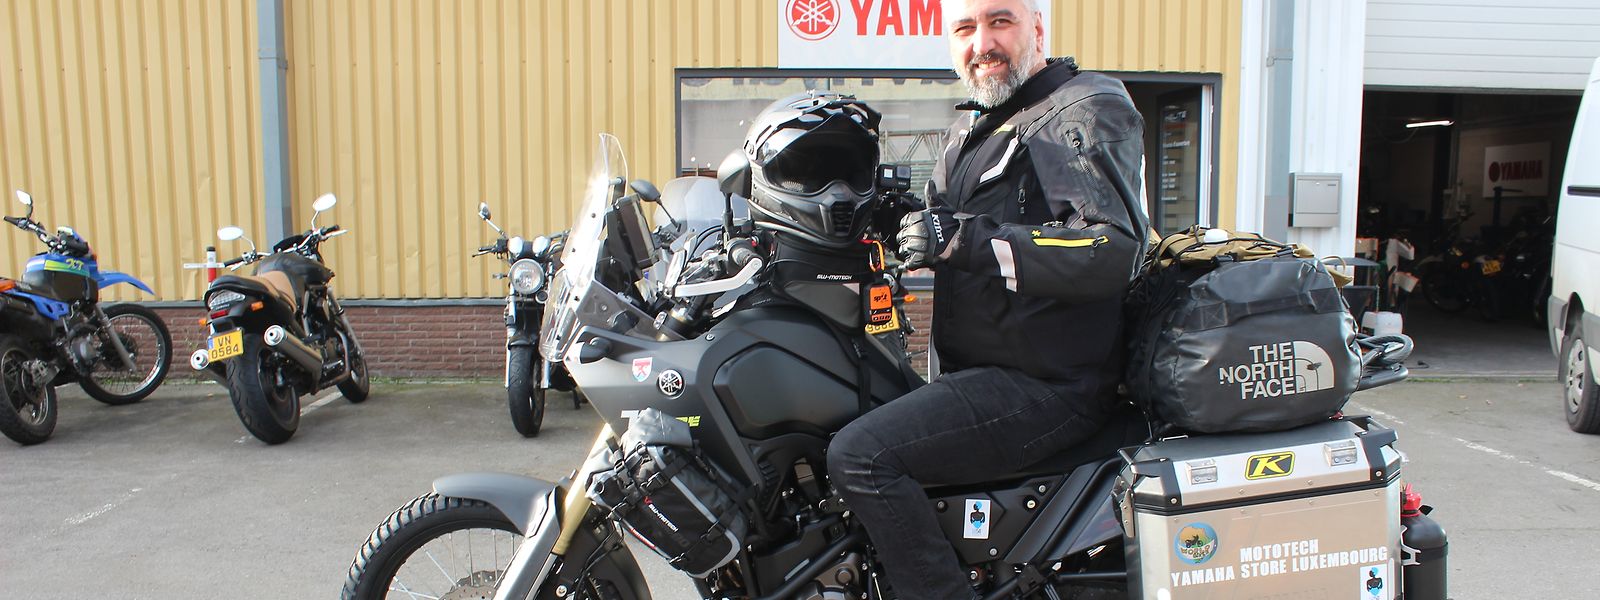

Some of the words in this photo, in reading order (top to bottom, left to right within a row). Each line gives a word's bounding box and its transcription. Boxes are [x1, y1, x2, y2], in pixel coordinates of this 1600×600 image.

[850, 0, 943, 36] YAM
[1501, 161, 1543, 180] YAMAHA
[211, 343, 240, 360] 0584
[217, 335, 232, 347] VN
[1249, 341, 1293, 363] THE
[1219, 360, 1294, 385] NORTH
[1241, 377, 1295, 400] FACE
[1240, 539, 1319, 563] MOTOTECH
[1170, 565, 1236, 587] YAMAHA
[1240, 559, 1287, 579] STORE
[1292, 546, 1388, 572] LUXEMBOURG
